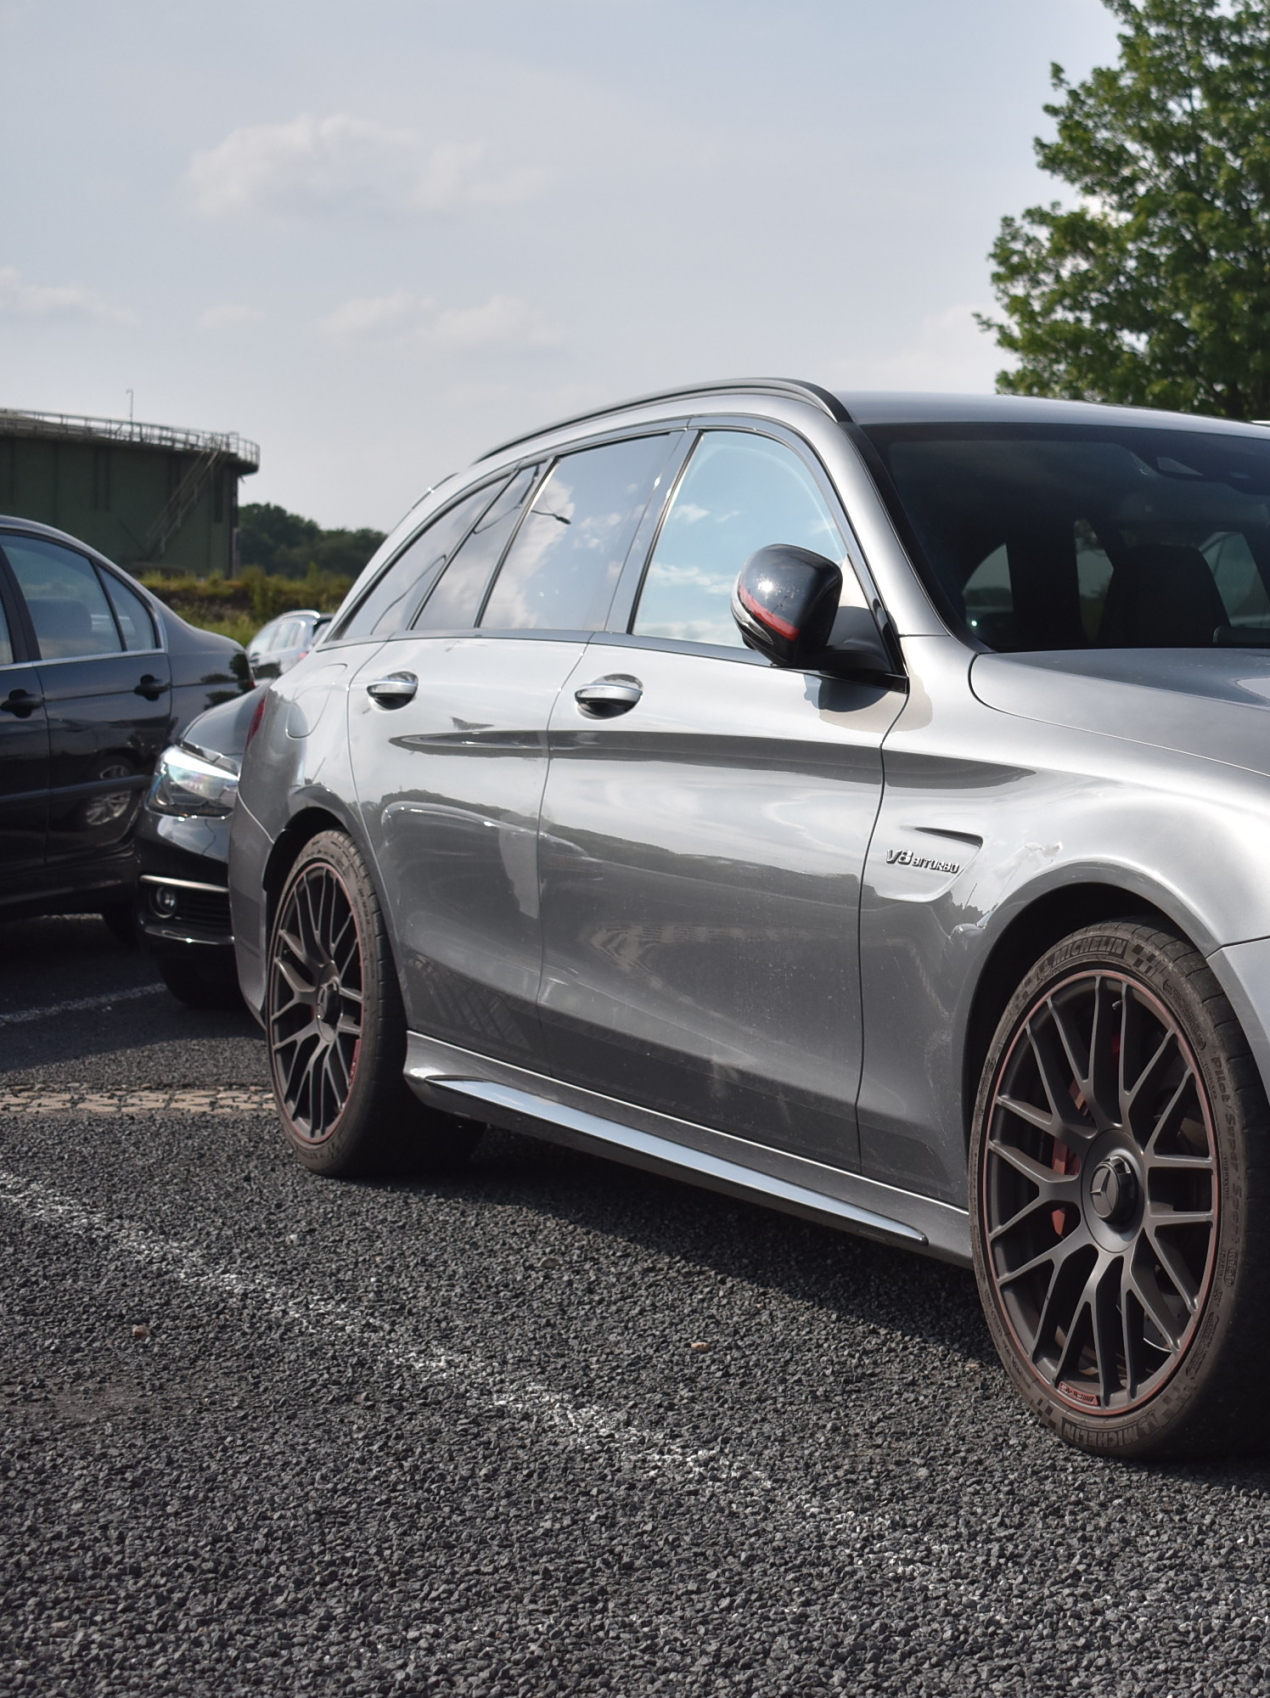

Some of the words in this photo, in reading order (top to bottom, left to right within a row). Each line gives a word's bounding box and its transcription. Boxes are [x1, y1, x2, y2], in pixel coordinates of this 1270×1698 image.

[886, 849, 914, 866] V8
[911, 857, 960, 874] BITURBO
[1052, 936, 1127, 966] MICHELIN
[1062, 1421, 1139, 1448] MICHELIN
